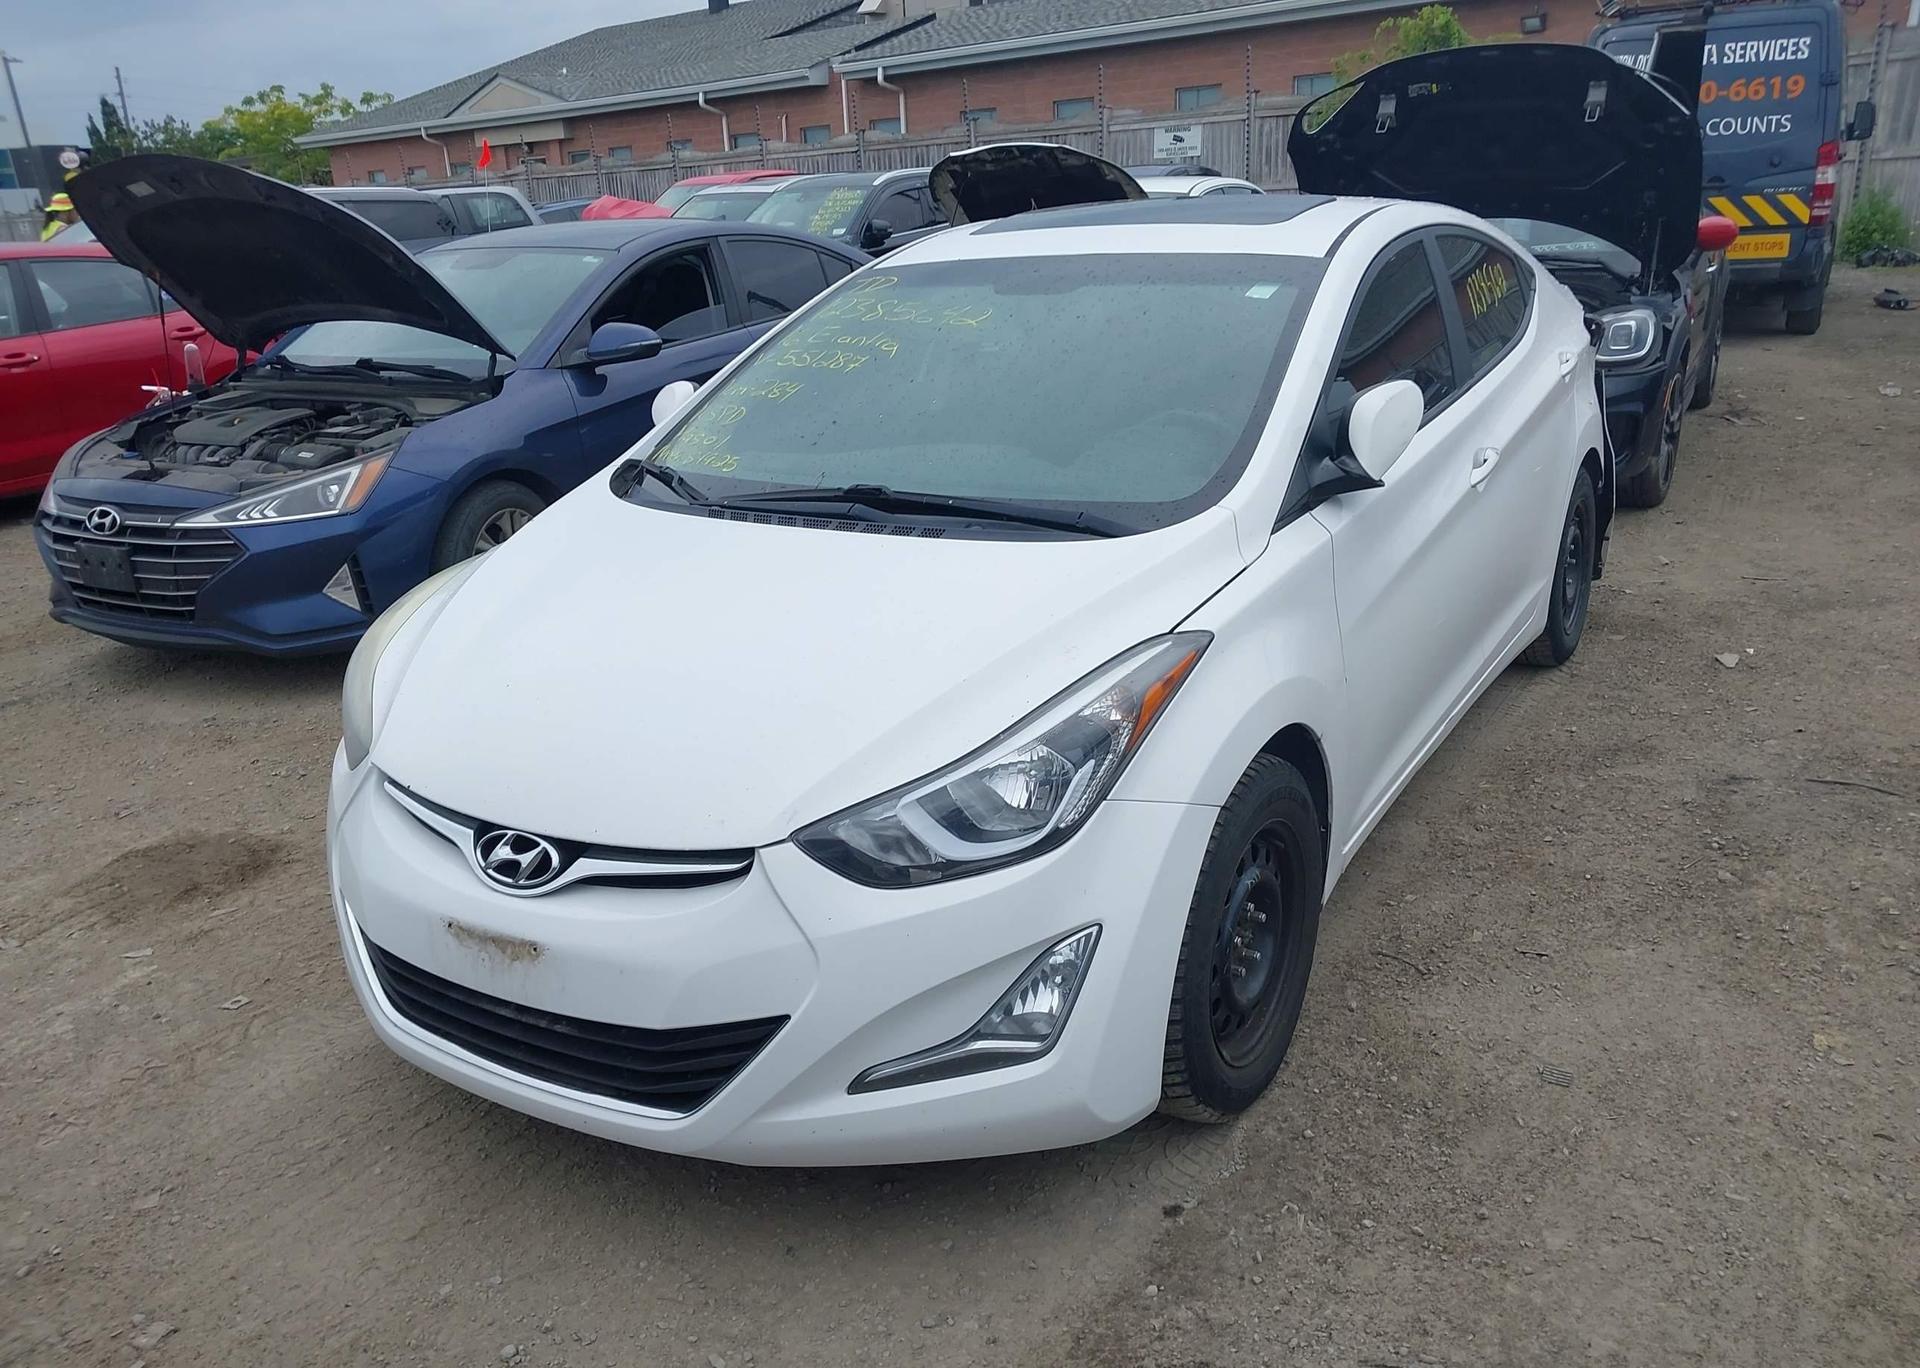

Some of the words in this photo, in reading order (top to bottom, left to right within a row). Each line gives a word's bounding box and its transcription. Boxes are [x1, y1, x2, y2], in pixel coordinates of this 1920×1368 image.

[1722, 37, 1811, 64] SERVICES
[1700, 74, 1806, 104] 0-6619
[1165, 126, 1192, 134] WARNING
[1706, 114, 1792, 136] COUNTS
[1753, 240, 1784, 252] STOPS
